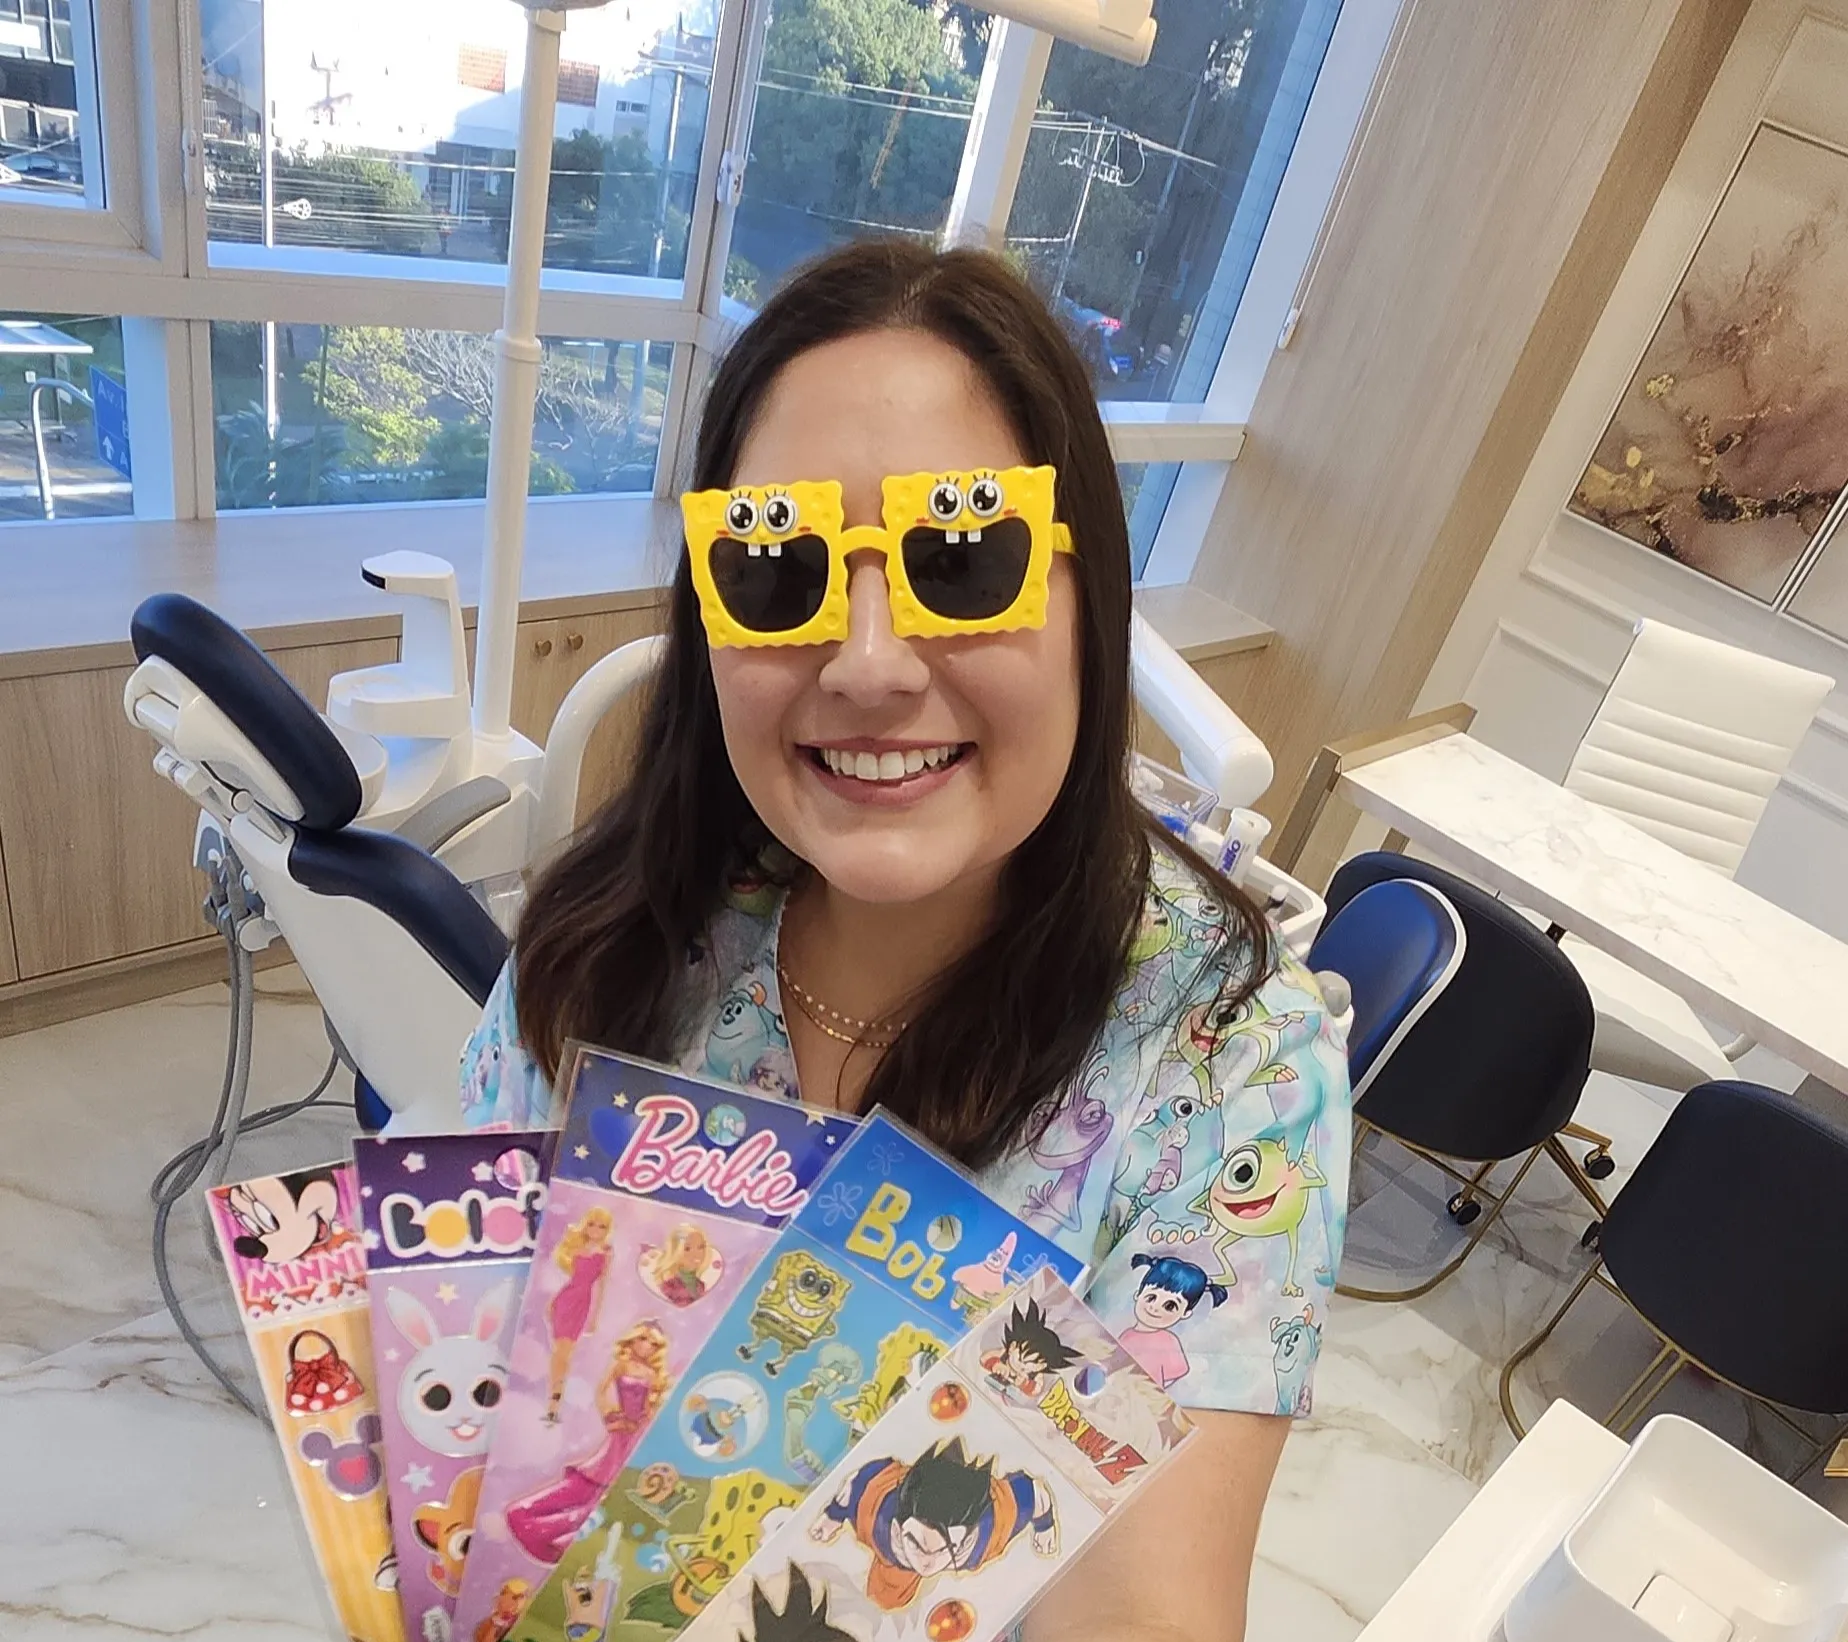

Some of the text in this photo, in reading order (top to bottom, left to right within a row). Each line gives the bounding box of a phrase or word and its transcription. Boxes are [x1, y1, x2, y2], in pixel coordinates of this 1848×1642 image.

[611, 1095, 809, 1216] Barbie
[845, 1181, 947, 1300] Bob
[1038, 1376, 1090, 1444] DRAGON
[1093, 1443, 1148, 1485] Z
